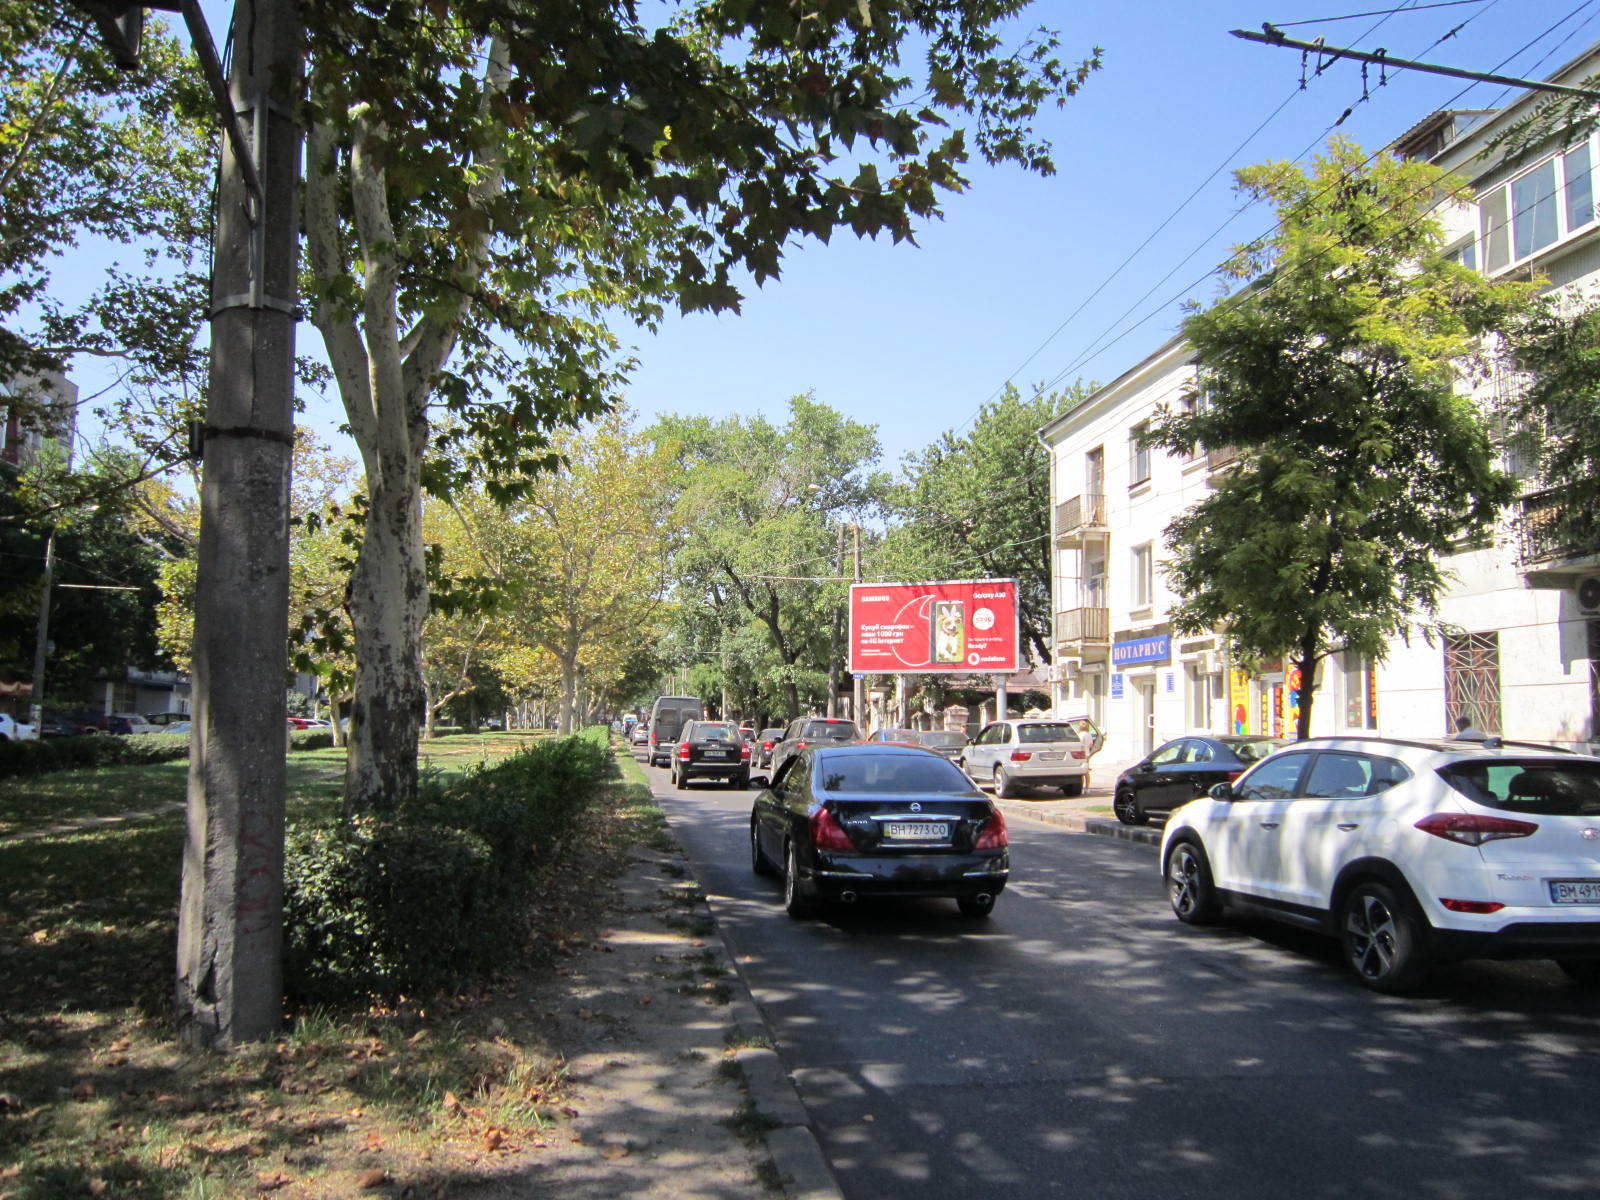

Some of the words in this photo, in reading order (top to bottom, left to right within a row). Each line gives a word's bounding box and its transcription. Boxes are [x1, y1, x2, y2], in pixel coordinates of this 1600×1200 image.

[1114, 640, 1165, 660] НОТАРИУС
[890, 824, 906, 835] BH
[907, 824, 930, 835] 7273
[1559, 884, 1577, 898] BM
